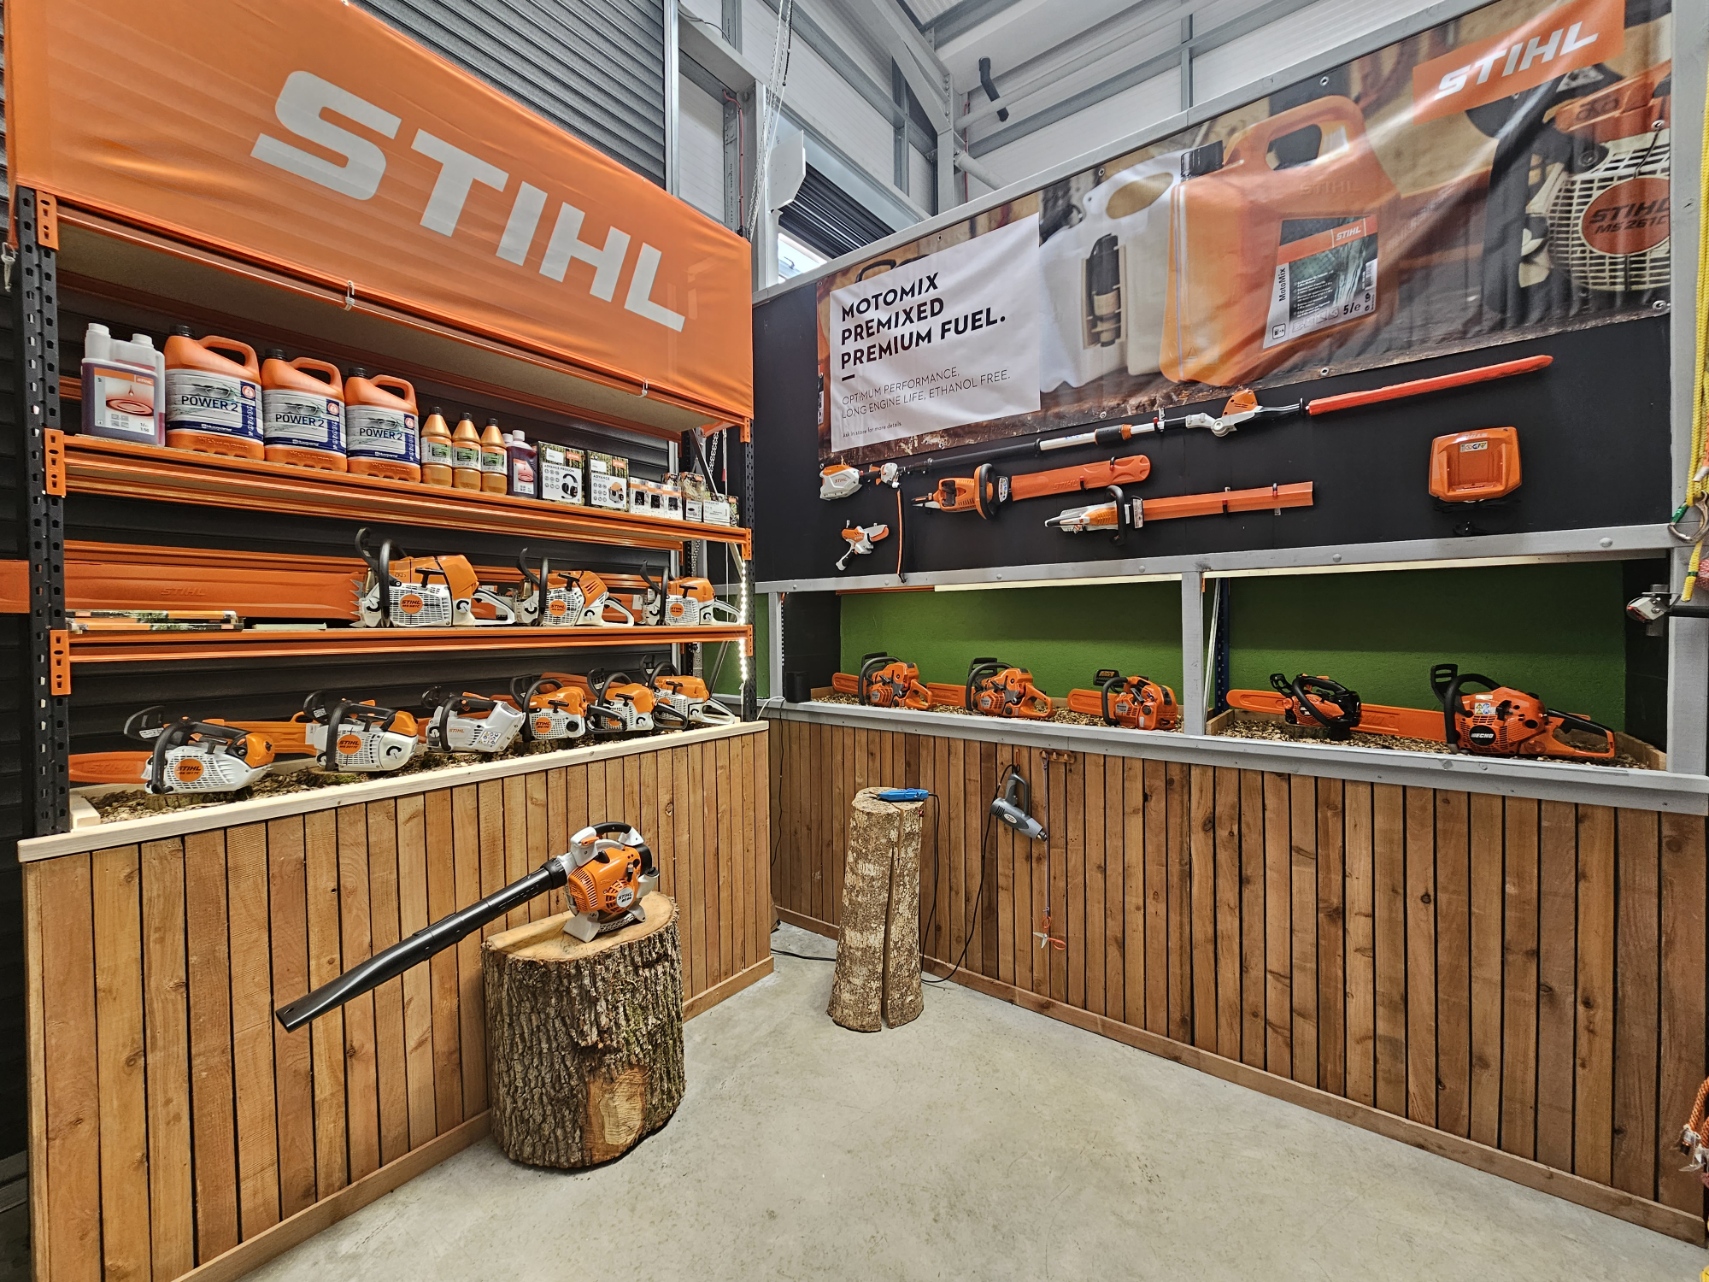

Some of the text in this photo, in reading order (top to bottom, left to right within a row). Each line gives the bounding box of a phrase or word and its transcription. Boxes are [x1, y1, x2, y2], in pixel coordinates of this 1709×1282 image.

[1434, 21, 1598, 101] STIHL
[250, 70, 687, 332] STIHL
[1336, 225, 1361, 241] STIHL
[1594, 222, 1621, 235] MS
[841, 272, 939, 322] MOTOMIX
[841, 297, 944, 346] PREMIXED
[841, 306, 1006, 370] PREMIUM FUEL.
[842, 405, 867, 419] LONG
[869, 396, 901, 413] ENGINE
[929, 379, 978, 399] ETHANOL
[980, 369, 1011, 386] FREE.
[842, 386, 882, 406] OPTIMUM
[181, 395, 239, 413] POWER 2
[275, 413, 325, 428] POWER 2
[874, 424, 886, 432] more
[360, 427, 403, 441] POWER 2
[160, 587, 206, 597] STIHL
